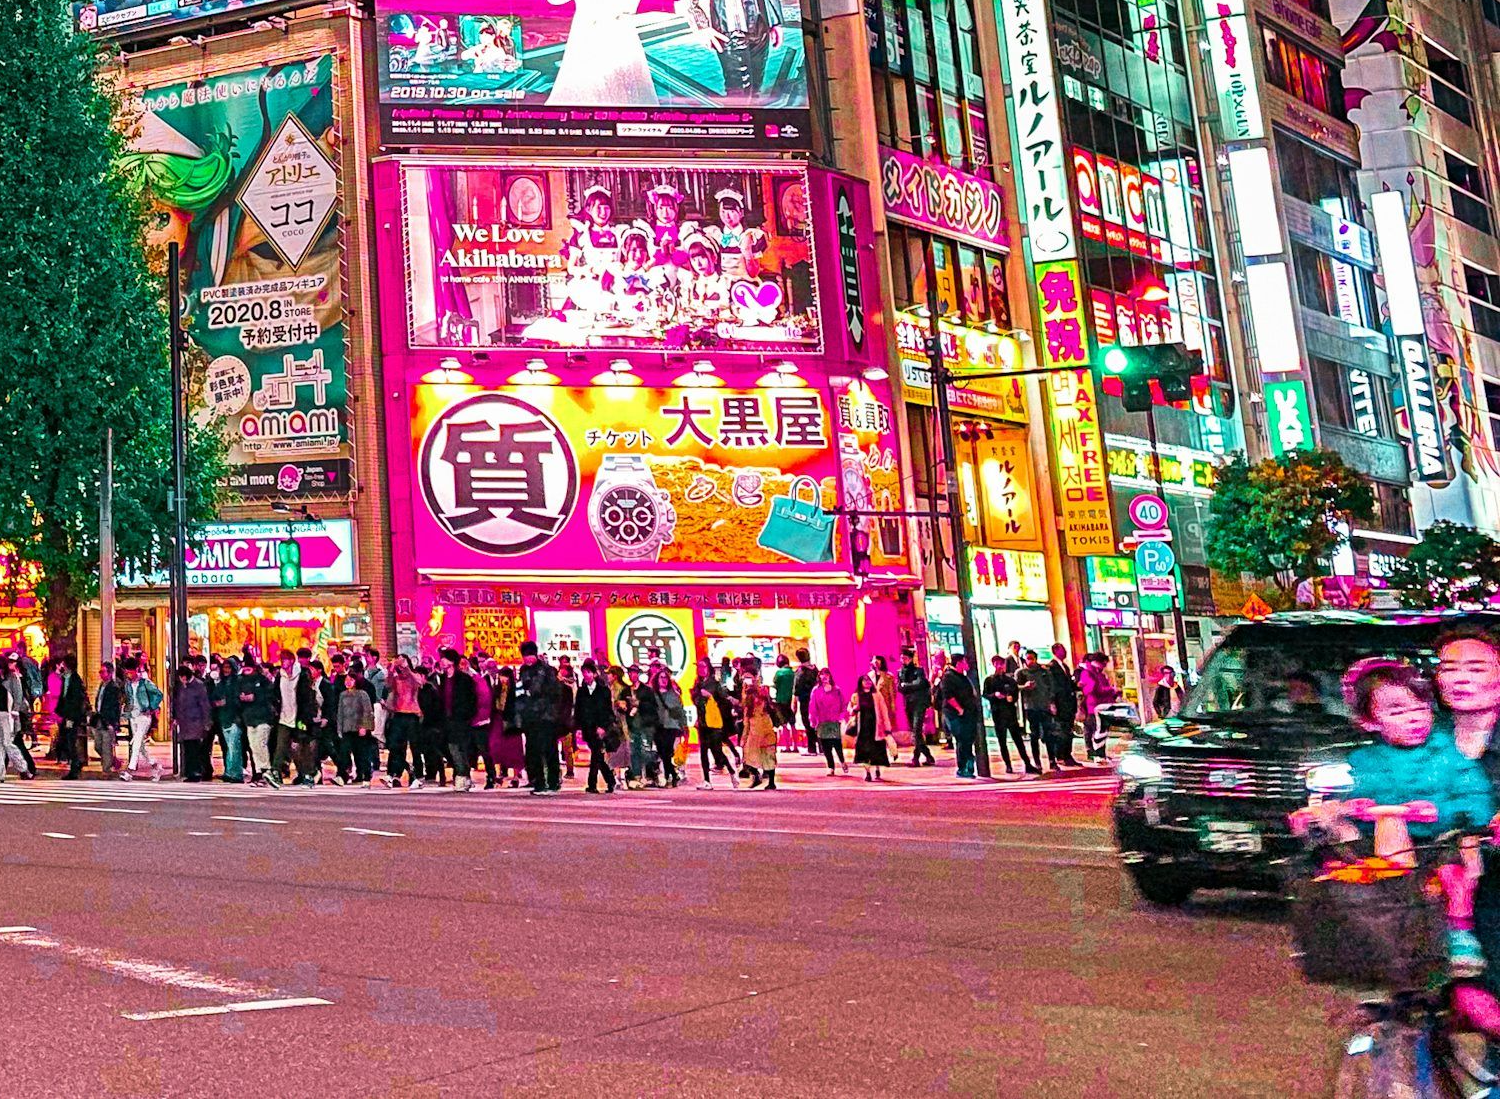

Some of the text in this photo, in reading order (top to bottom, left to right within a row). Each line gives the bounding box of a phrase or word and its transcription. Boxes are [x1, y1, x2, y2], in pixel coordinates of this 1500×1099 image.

[390, 86, 466, 99] 2019.10.30
[266, 163, 321, 187] アトリエ
[882, 156, 1001, 239] メイドカジノ
[270, 199, 315, 229] ココ
[282, 229, 304, 238] COCO
[452, 224, 545, 243] We Love
[439, 248, 562, 268] Akihabara
[210, 299, 282, 326] 2020.8
[283, 300, 293, 308] IN
[284, 306, 312, 318] STORE
[1039, 270, 1087, 364] 免税
[242, 322, 318, 348] 予約受付中
[1400, 339, 1442, 477] GALLERIA
[242, 409, 337, 437] amiami
[661, 393, 829, 451] 大黒屋
[586, 428, 654, 448] チケット
[1075, 371, 1106, 502] TAX FREE
[250, 474, 275, 487] more
[441, 417, 564, 536] 質
[999, 460, 1022, 534] ルノアール
[1140, 505, 1159, 521] 40
[1069, 523, 1109, 532] AKIHABARA
[1071, 536, 1110, 546] TOKIS
[1144, 550, 1159, 571] P
[547, 640, 580, 651] 大黒屋
